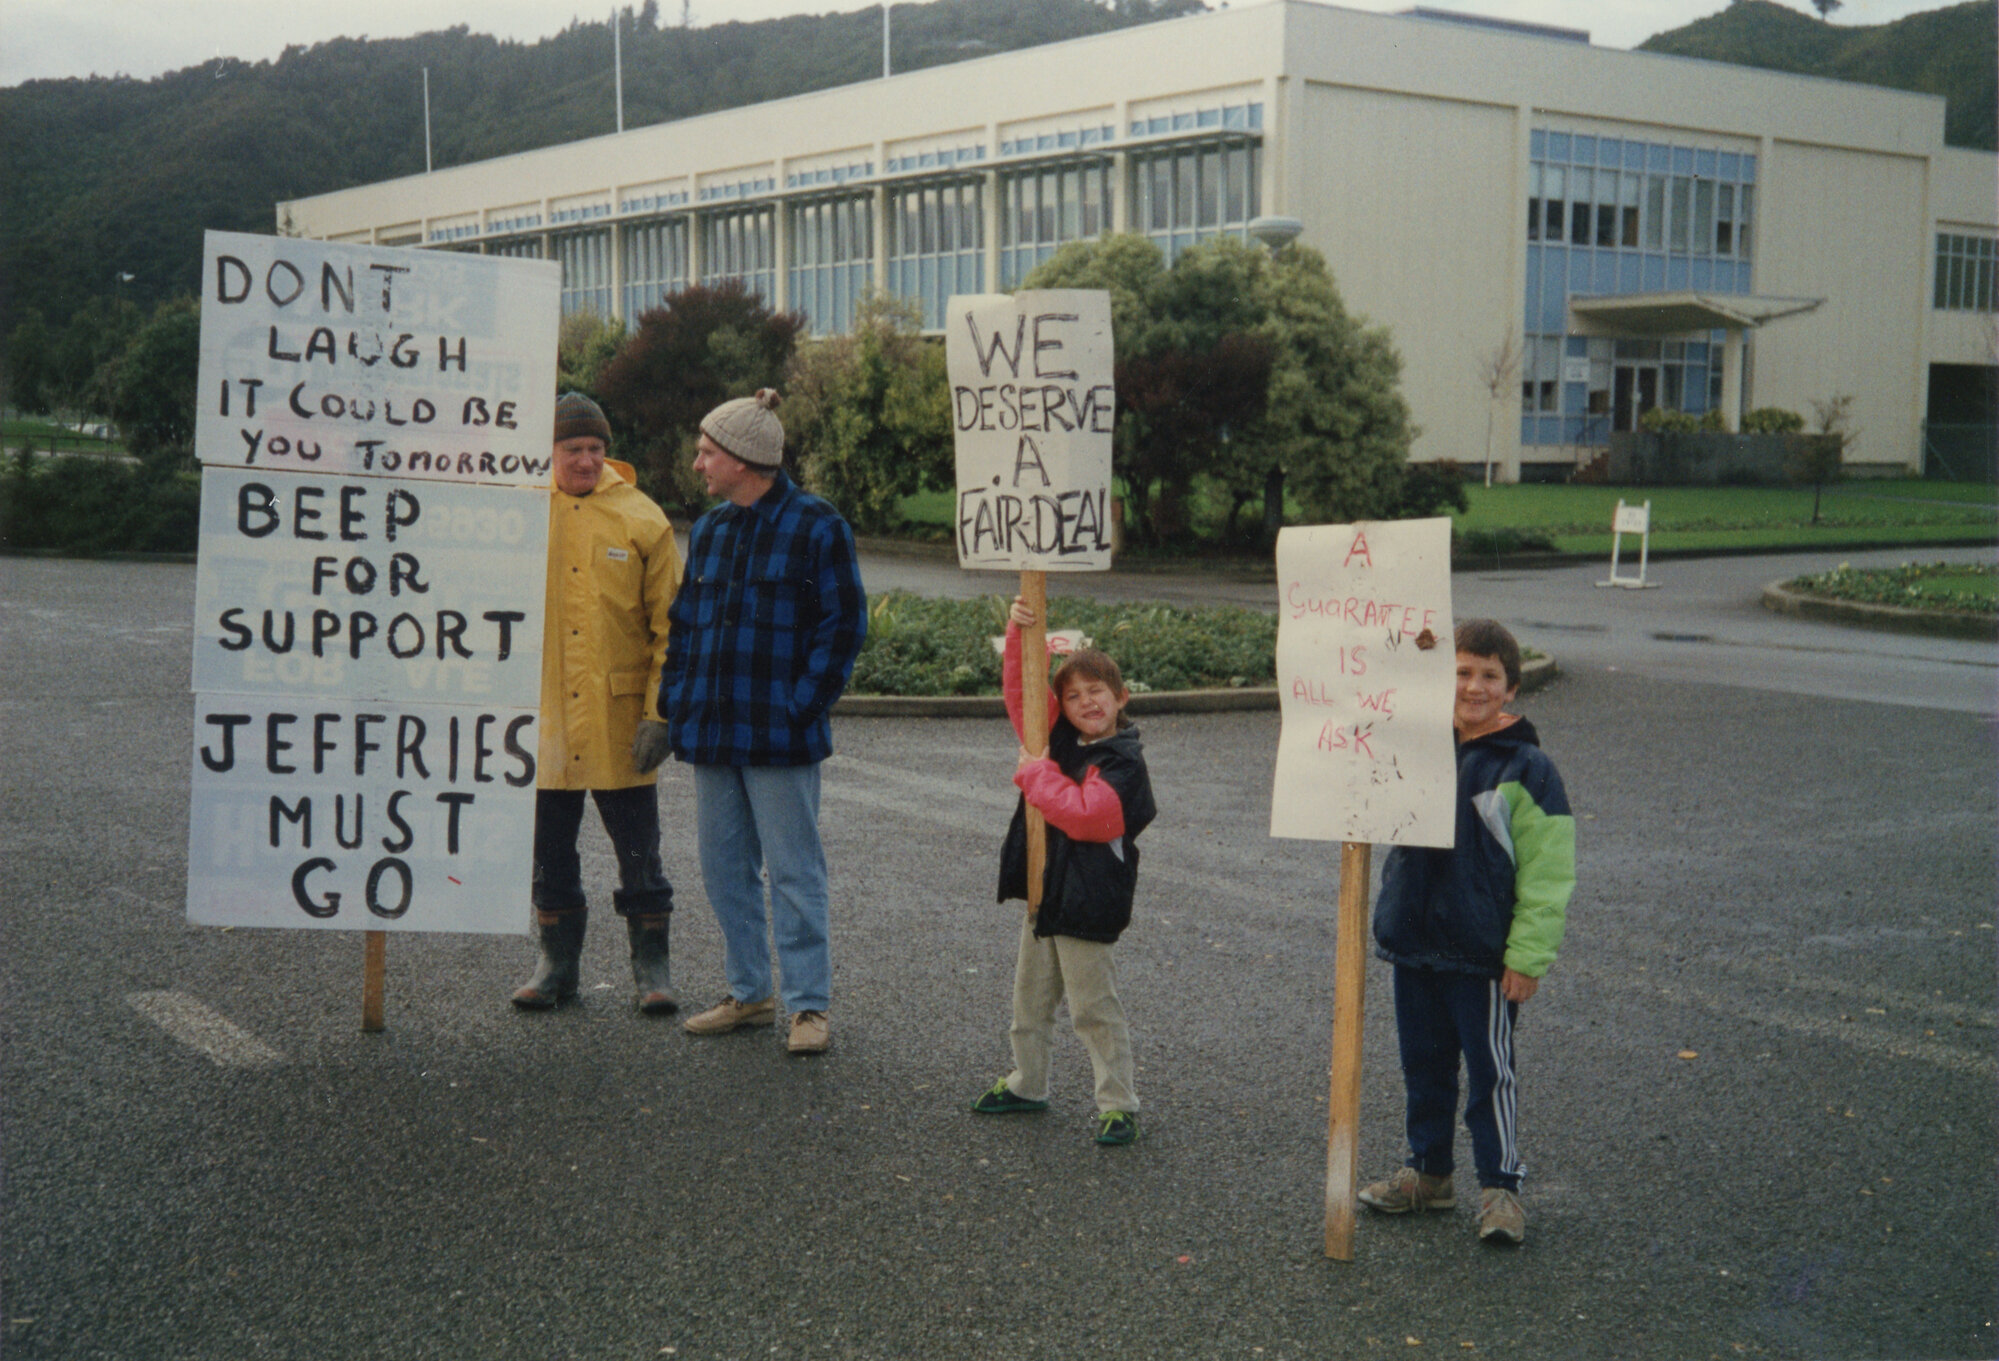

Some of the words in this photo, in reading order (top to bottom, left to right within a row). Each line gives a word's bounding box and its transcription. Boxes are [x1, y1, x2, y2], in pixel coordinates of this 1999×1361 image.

[217, 255, 410, 313] DONT
[268, 325, 466, 372] LAUGH
[965, 310, 1079, 381] WE
[219, 378, 264, 417] IT
[289, 381, 436, 426] COULD
[462, 396, 518, 430] BE
[955, 383, 1113, 433] DESERVE
[240, 428, 322, 464] YOU
[354, 440, 551, 476] TOMORROW
[1013, 433, 1050, 487] A
[237, 481, 420, 542] BEEP
[312, 552, 429, 597] FOR
[1344, 531, 1373, 568] A
[218, 607, 527, 661] SUPPORT
[1340, 645, 1367, 675] IS
[1293, 675, 1334, 707] ALL
[1356, 688, 1397, 713] WE
[200, 712, 536, 788] JEFFRIES
[1318, 719, 1374, 760] ASK
[269, 790, 475, 855] MUST
[291, 856, 413, 920] GO
